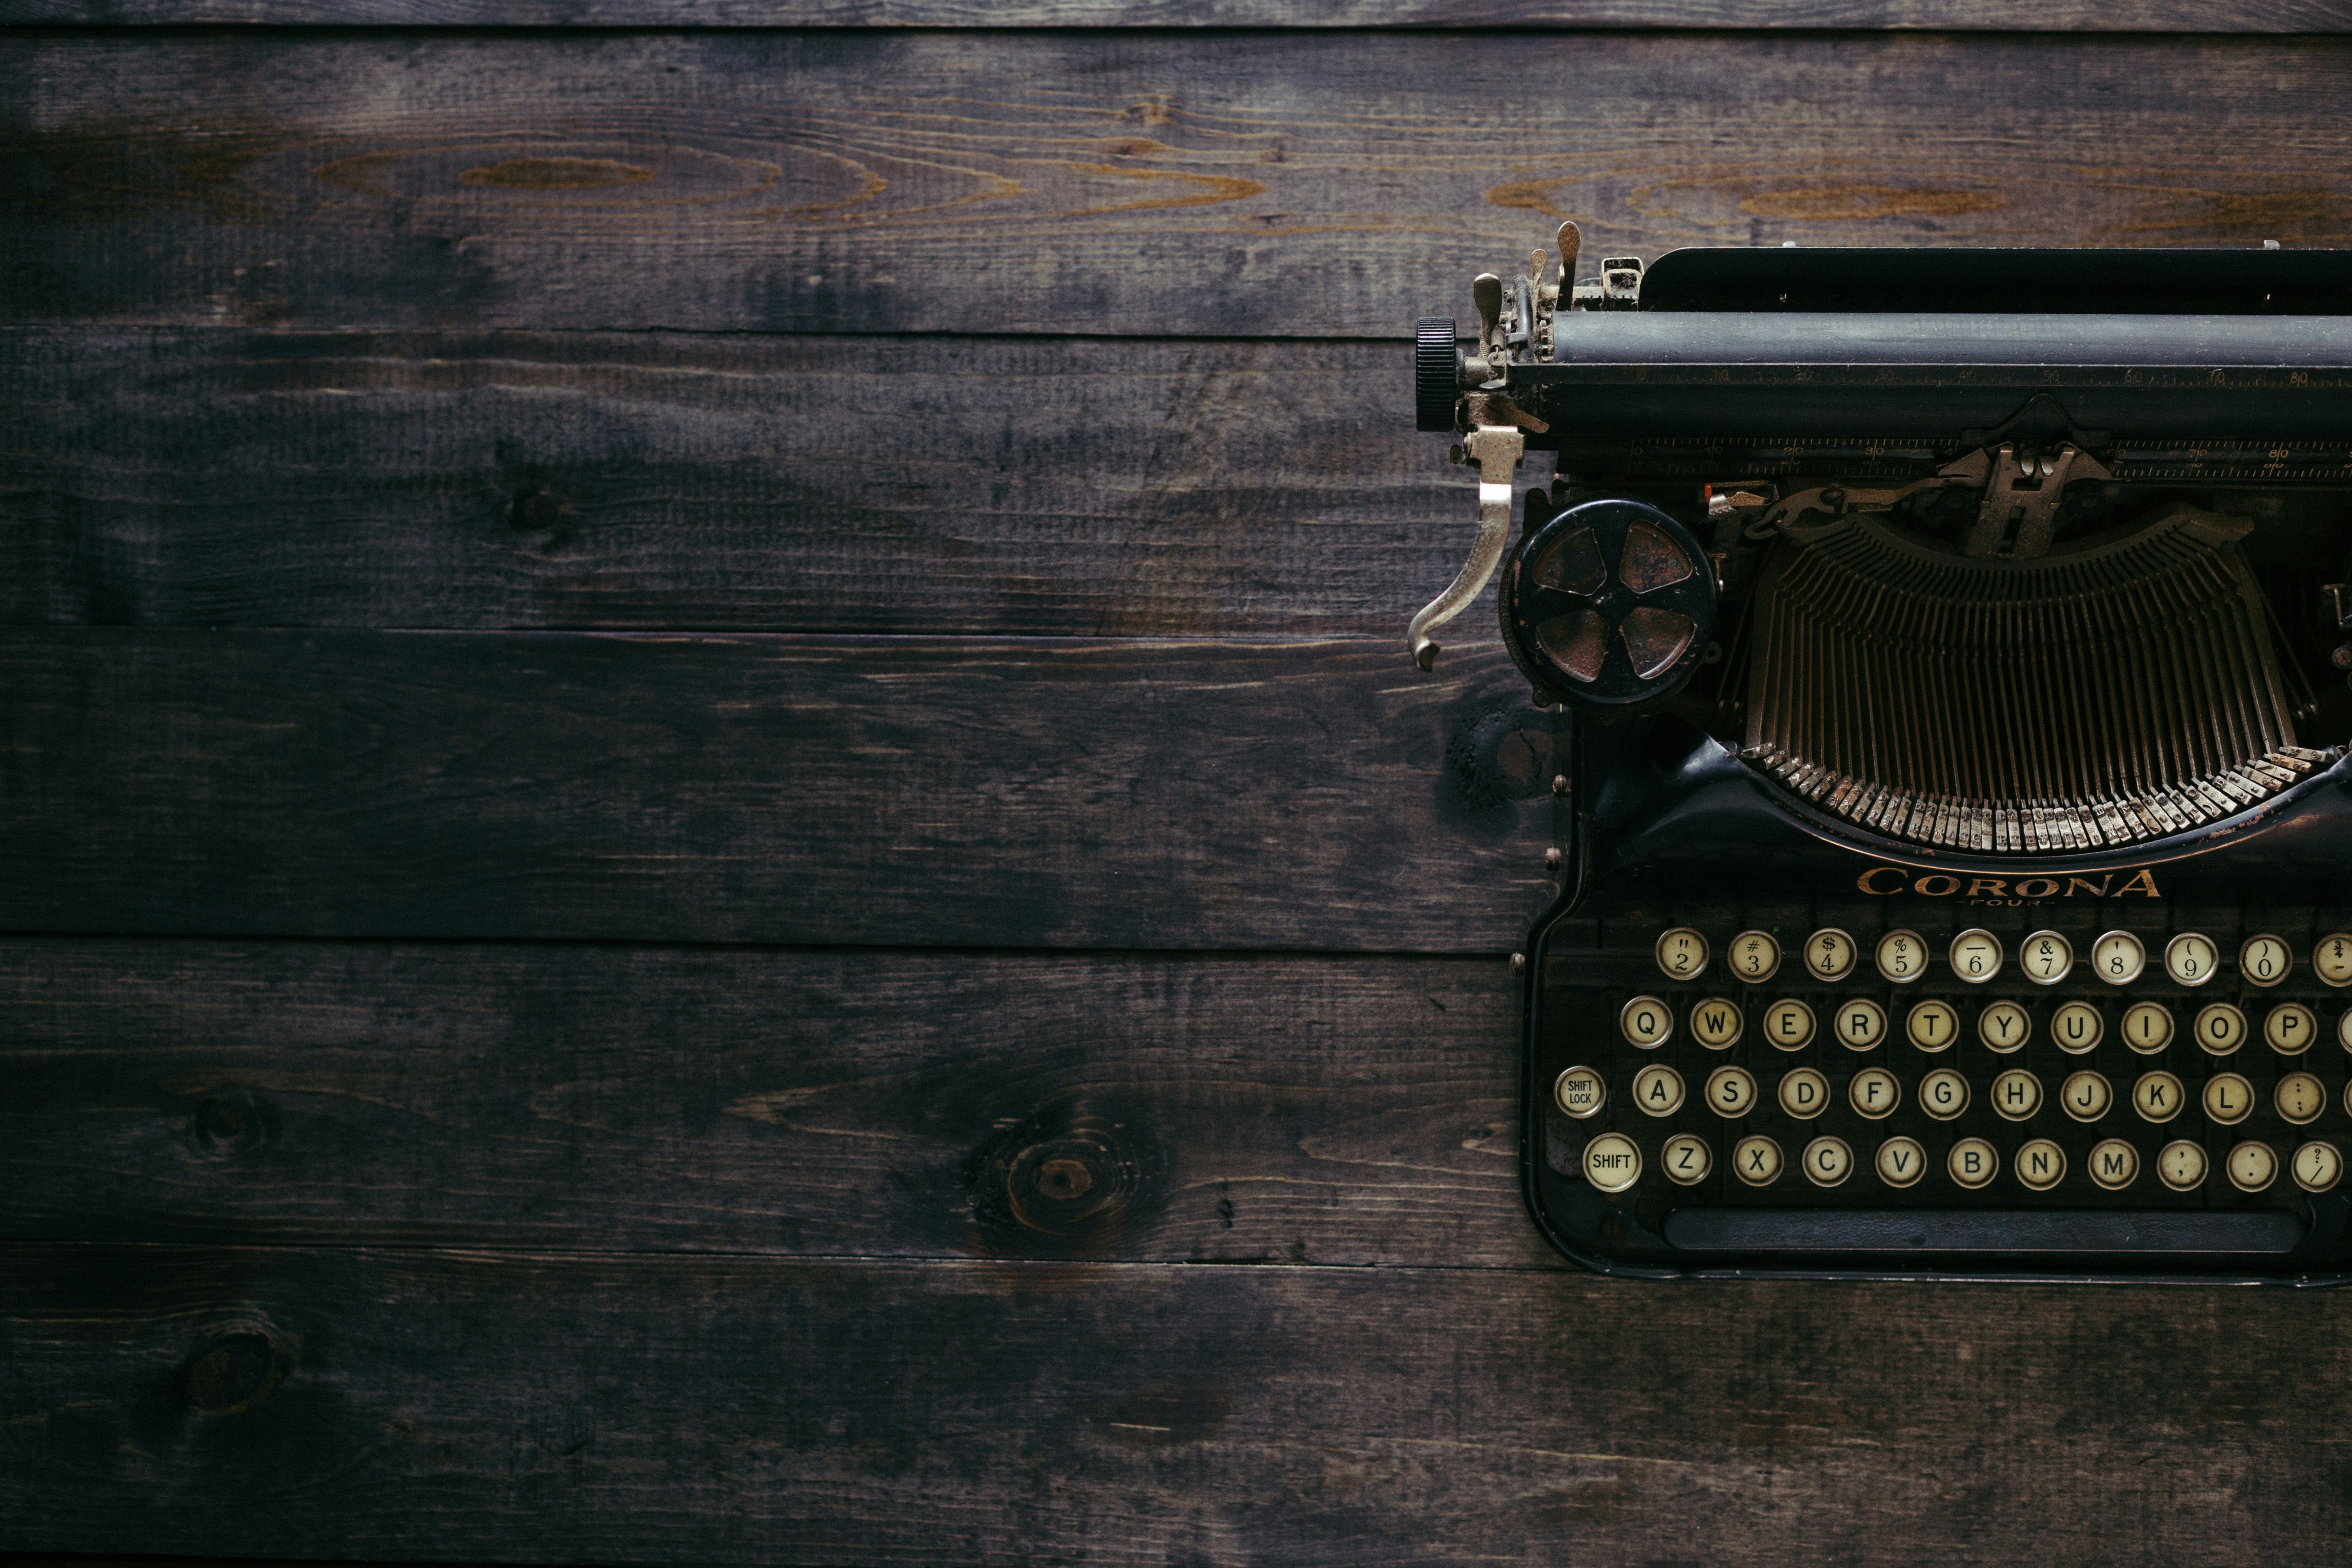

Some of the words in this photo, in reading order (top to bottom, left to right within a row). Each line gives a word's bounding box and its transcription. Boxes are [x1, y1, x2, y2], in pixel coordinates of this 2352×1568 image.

[1959, 370, 1976, 381] 40
[2043, 370, 2060, 382] 50
[2125, 371, 2142, 382] 60
[2209, 370, 2225, 383] 70
[2290, 372, 2308, 383] 80
[1784, 446, 1804, 455] 20
[1865, 447, 1885, 456] 30
[2189, 449, 2208, 458] 70
[2269, 449, 2289, 458] 80
[1856, 867, 2161, 898] CORONA
[1747, 940, 1760, 952] #
[1822, 936, 1835, 951] $
[1895, 938, 1906, 952] %
[2040, 940, 2053, 955] &
[2186, 940, 2192, 955] (
[2262, 942, 2268, 957] )
[1675, 953, 1689, 971] 2
[1748, 955, 1759, 973] 3
[1821, 954, 1834, 971] 4
[1895, 955, 1908, 972] 5
[1969, 956, 1982, 973] 6
[2041, 958, 2052, 975] 7
[2110, 957, 2124, 974] 8
[2184, 959, 2197, 976] 9
[2258, 959, 2272, 977] 0
[1637, 1012, 1655, 1035] Q
[1705, 1011, 1726, 1034] W
[1782, 1013, 1796, 1035] E
[1852, 1014, 1869, 1035] R
[1923, 1015, 1939, 1036] T
[1996, 1015, 2012, 1038] Y
[2067, 1017, 2083, 1039] U
[2144, 1015, 2149, 1038] I
[2211, 1017, 2229, 1039] O
[2282, 1015, 2298, 1038] P
[1568, 1080, 1592, 1091] SHIFT
[1650, 1079, 1666, 1101] A
[1722, 1081, 1738, 1103] S
[1798, 1082, 1814, 1104] D
[1868, 1082, 1882, 1103] F
[1935, 1081, 1952, 1104] G
[2008, 1082, 2023, 1104] H
[2077, 1085, 2092, 1107] J
[2150, 1084, 2165, 1106] K
[1569, 1093, 1592, 1104] LOCK
[2220, 1087, 2233, 1109] L
[1593, 1154, 1631, 1169] SHIFT
[1679, 1147, 1694, 1169] Z
[1749, 1149, 1765, 1172] X
[1819, 1149, 1836, 1172] C
[1892, 1151, 1910, 1172] V
[1965, 1152, 1981, 1173] B
[2032, 1152, 2048, 1174] N
[2104, 1153, 2123, 1175] M
[2314, 1148, 2321, 1164] ?
[2310, 1166, 2323, 1182] /
